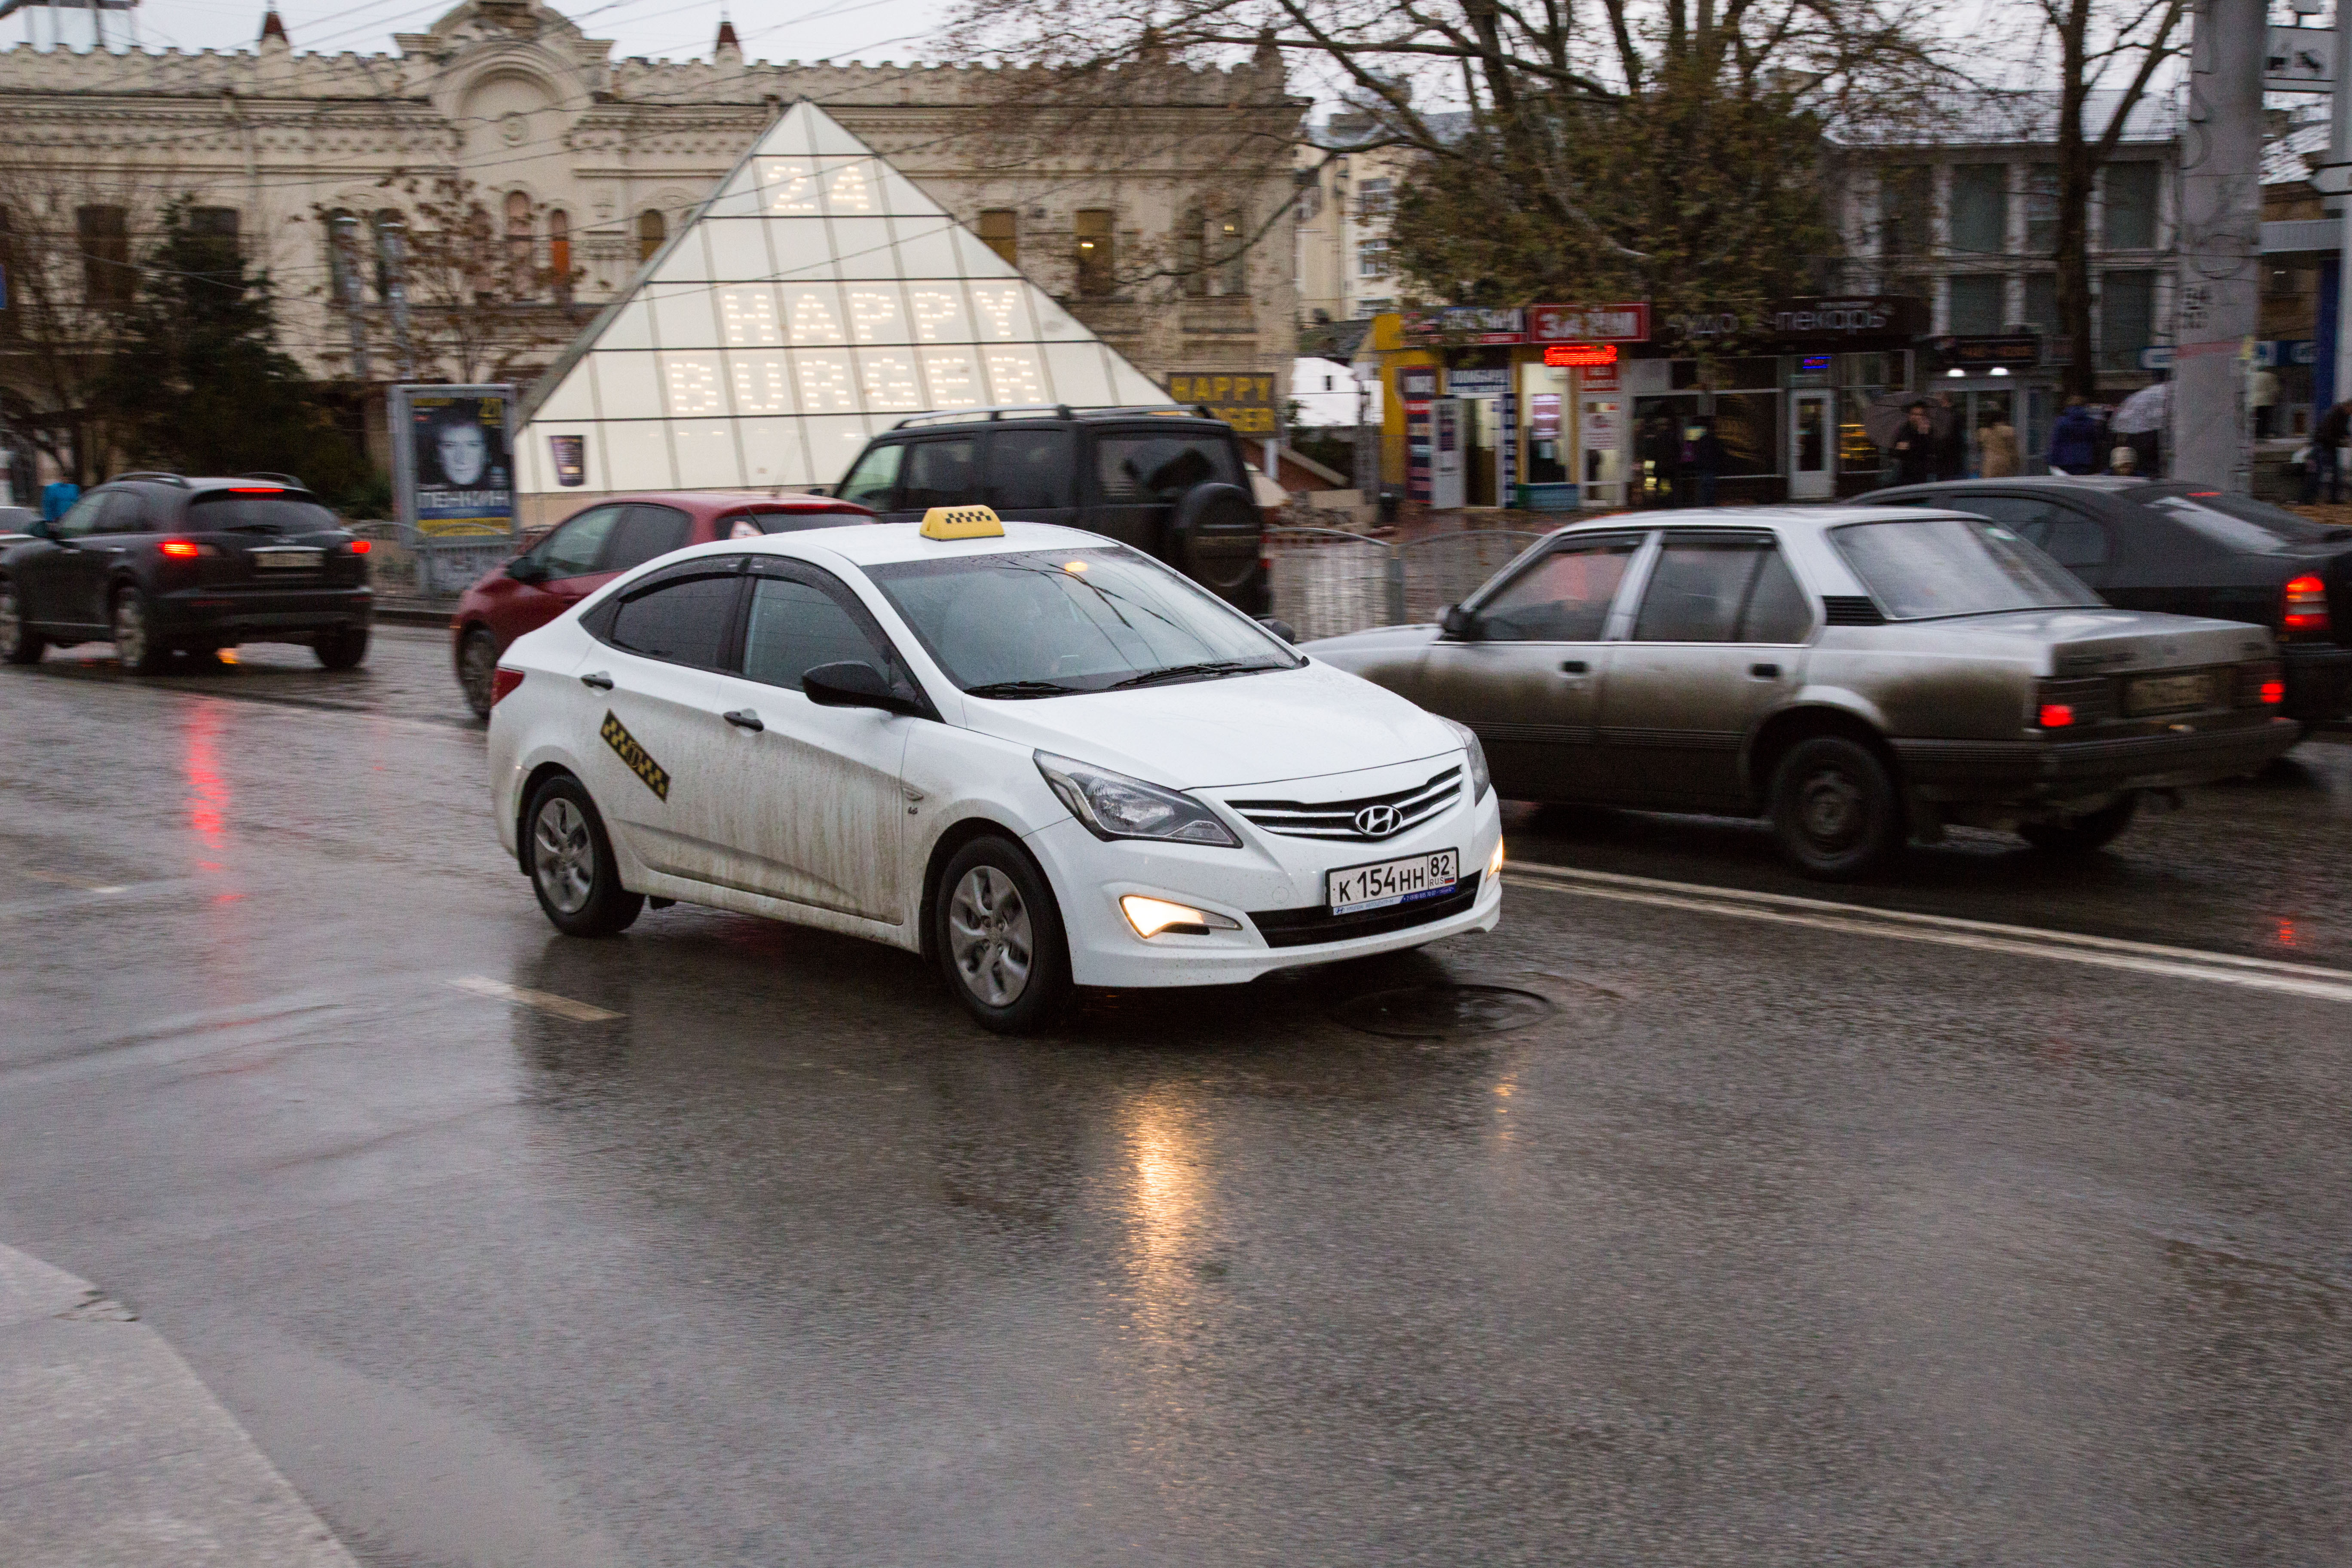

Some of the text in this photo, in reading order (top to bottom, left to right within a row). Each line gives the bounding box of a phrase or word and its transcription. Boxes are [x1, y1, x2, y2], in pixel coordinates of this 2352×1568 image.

[768, 165, 869, 209] 24
[725, 291, 1017, 342] HAPPY
[671, 357, 1041, 411] BURGER
[1170, 377, 1274, 401] HAPPY
[1429, 877, 1444, 887] RUS
[1430, 854, 1450, 877] 82
